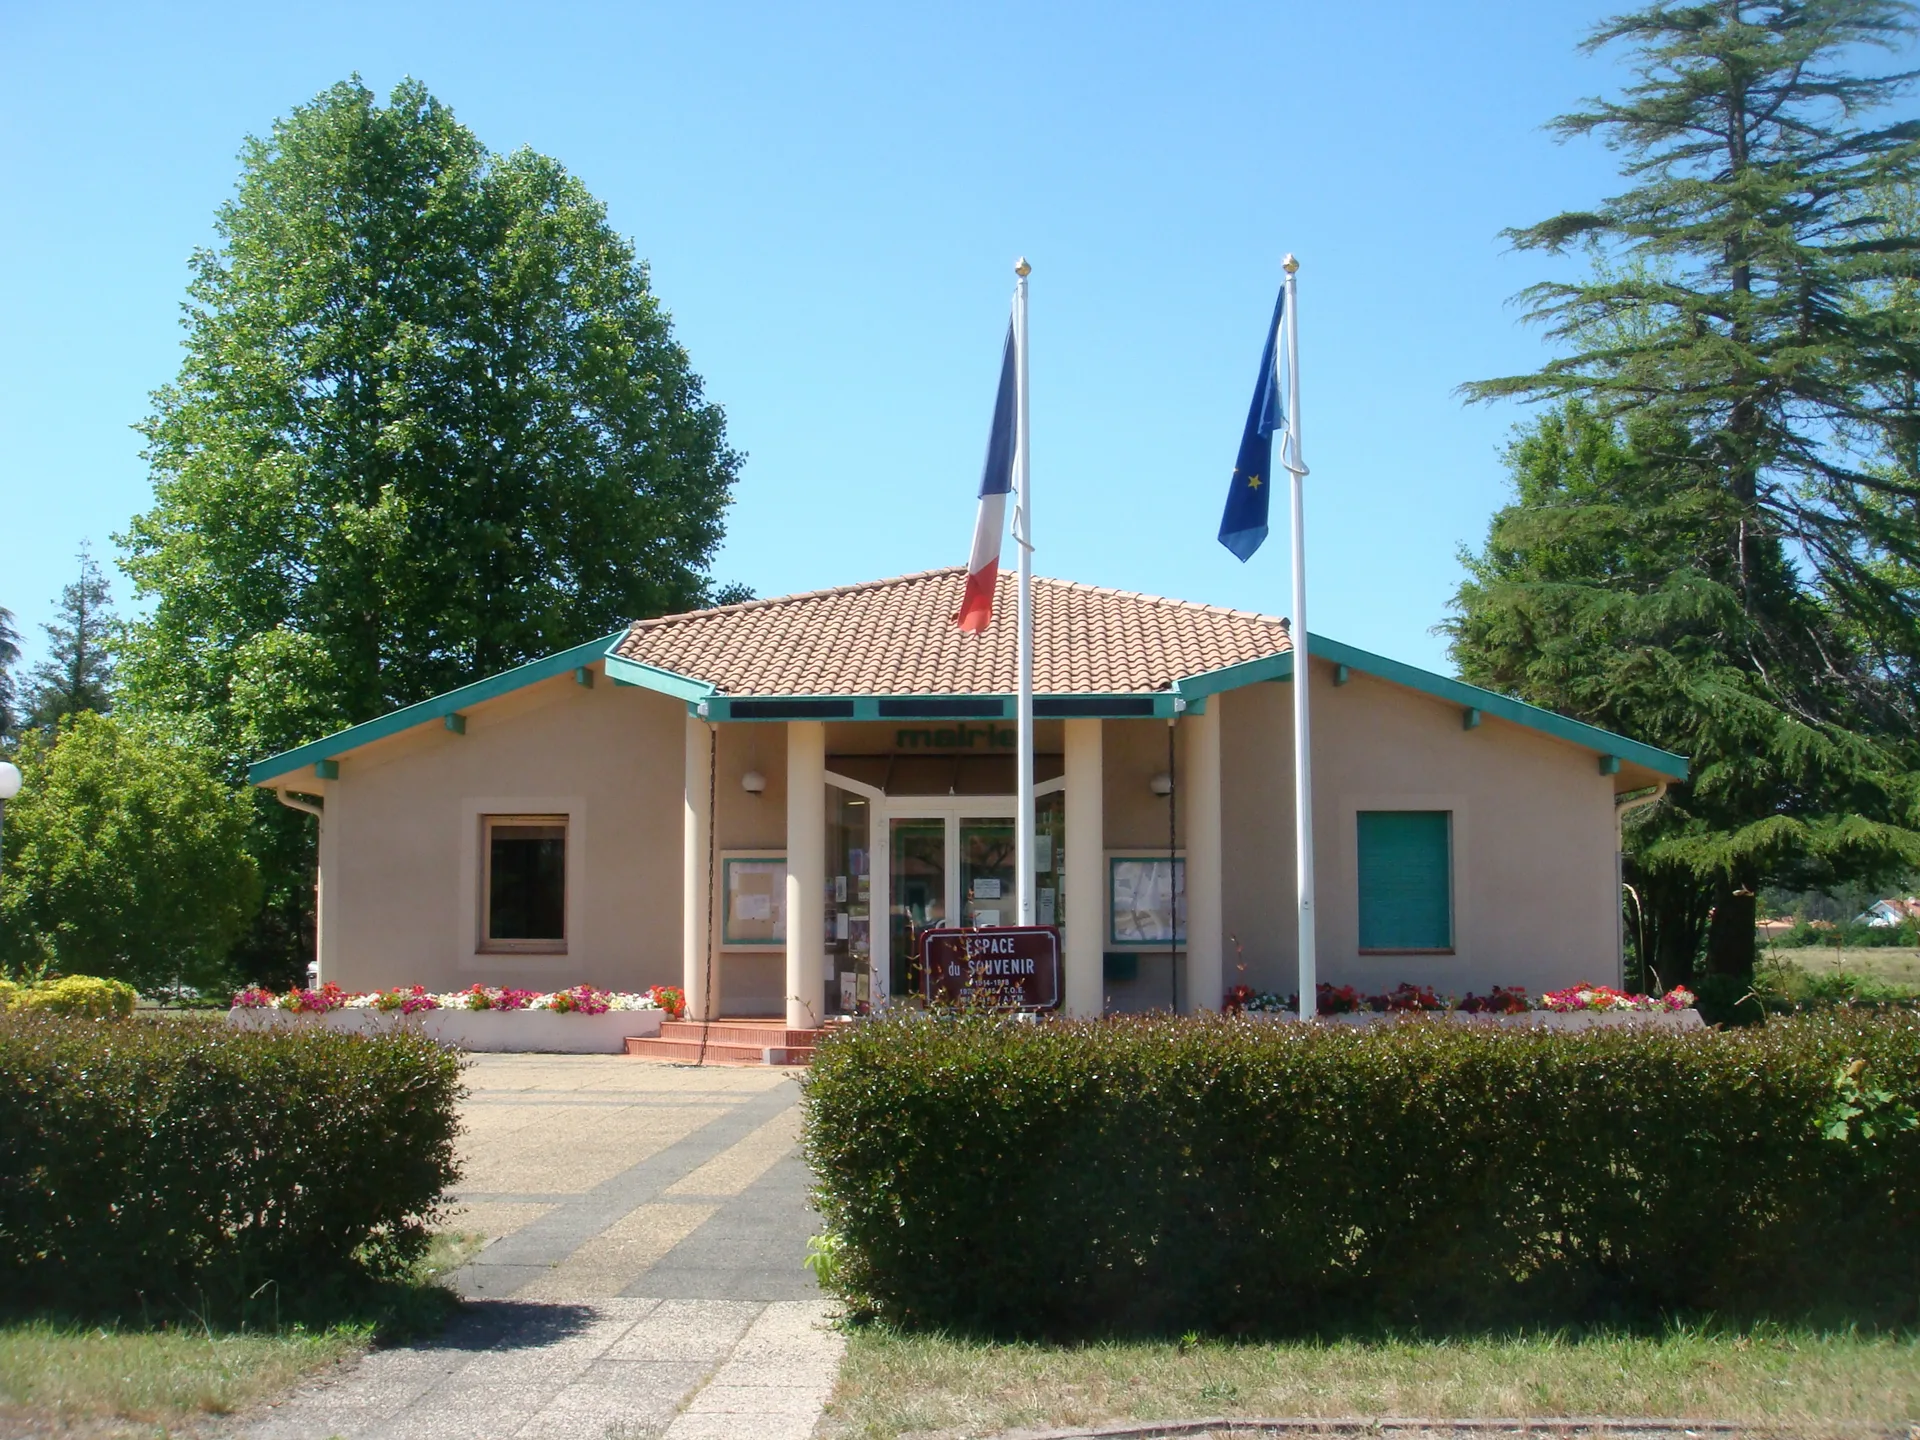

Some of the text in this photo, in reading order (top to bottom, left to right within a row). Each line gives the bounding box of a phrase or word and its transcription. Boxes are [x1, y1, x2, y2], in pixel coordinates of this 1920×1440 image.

[896, 723, 1018, 748] mairie
[966, 938, 1015, 955] ESPACE
[948, 959, 1035, 976] du SOUVENIR
